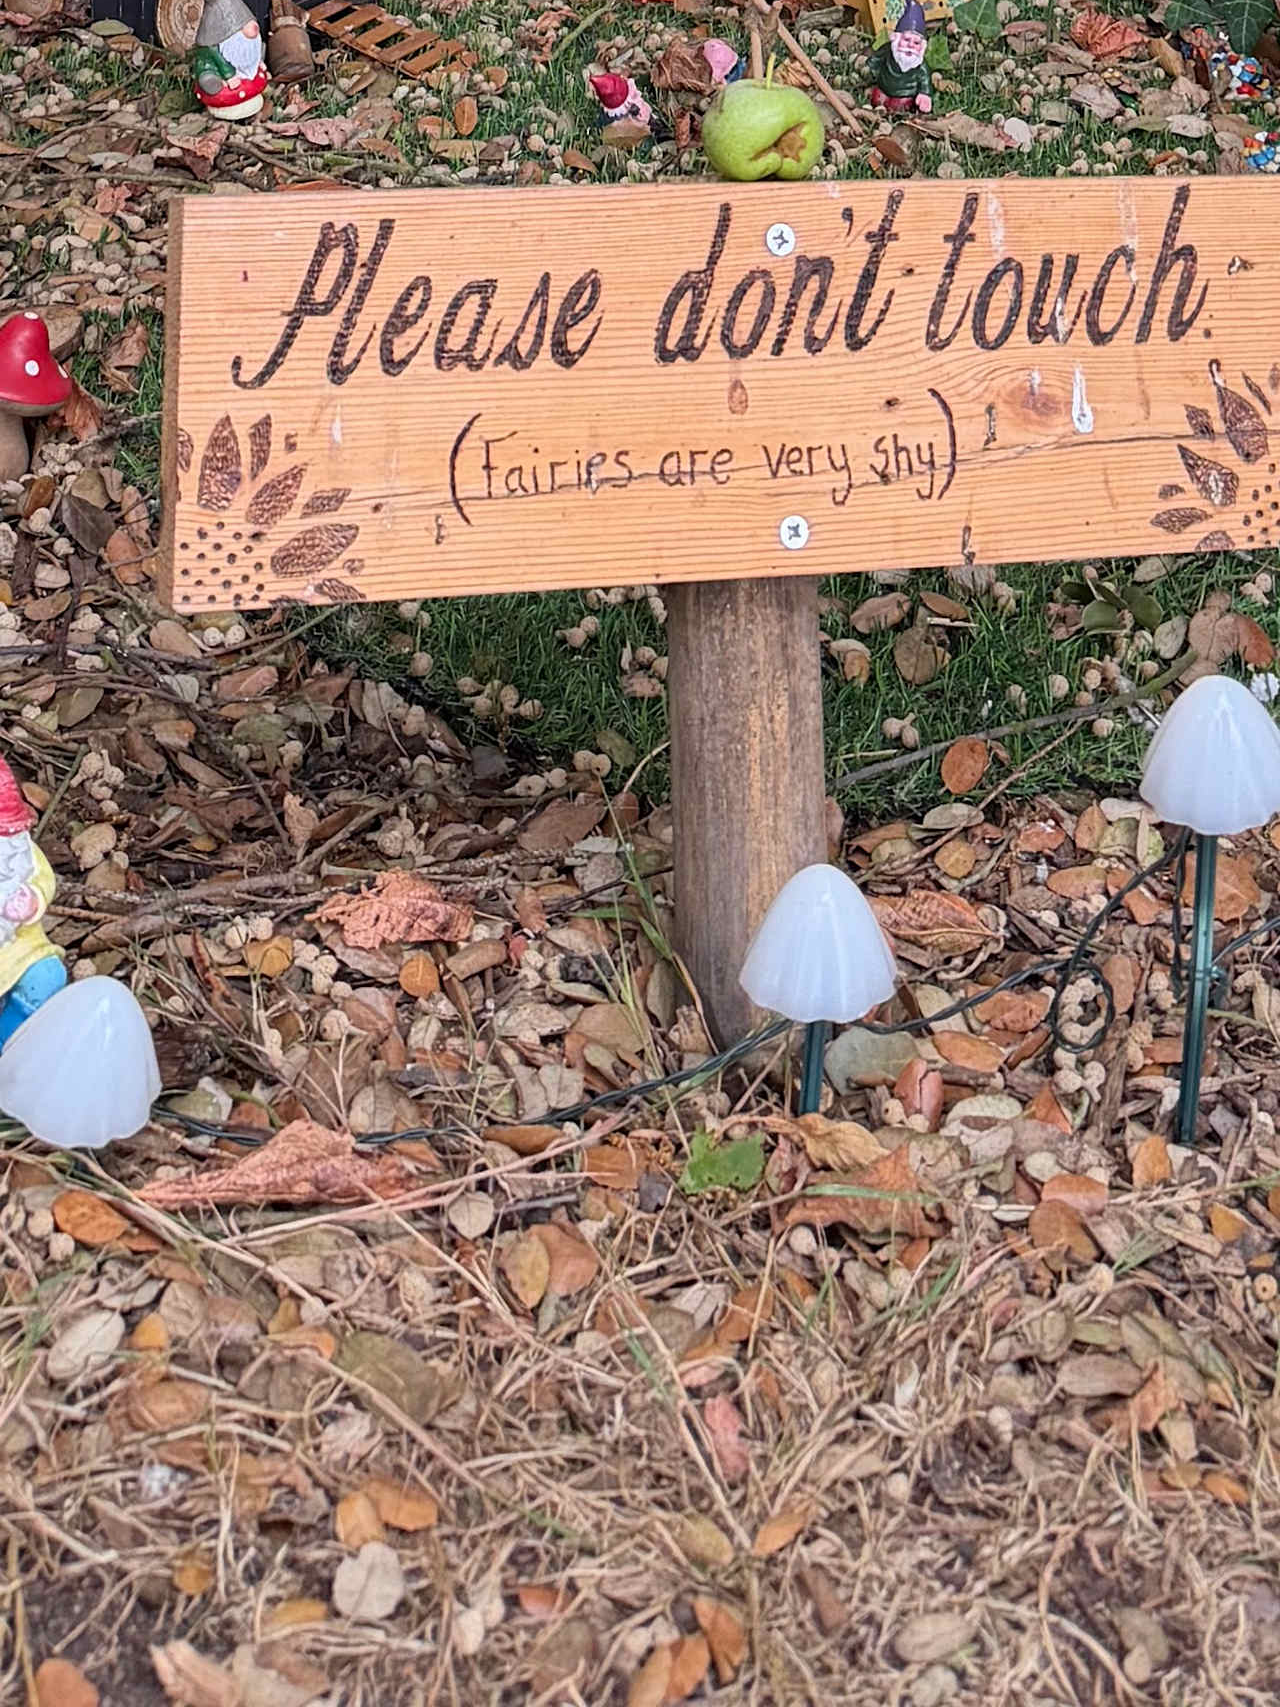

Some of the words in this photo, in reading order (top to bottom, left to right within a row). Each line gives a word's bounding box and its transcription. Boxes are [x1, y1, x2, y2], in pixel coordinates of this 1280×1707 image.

[232, 217, 606, 389] Please
[655, 188, 904, 364] don't
[450, 413, 632, 526] (Fairies
[659, 446, 734, 487] are
[761, 443, 852, 506] very
